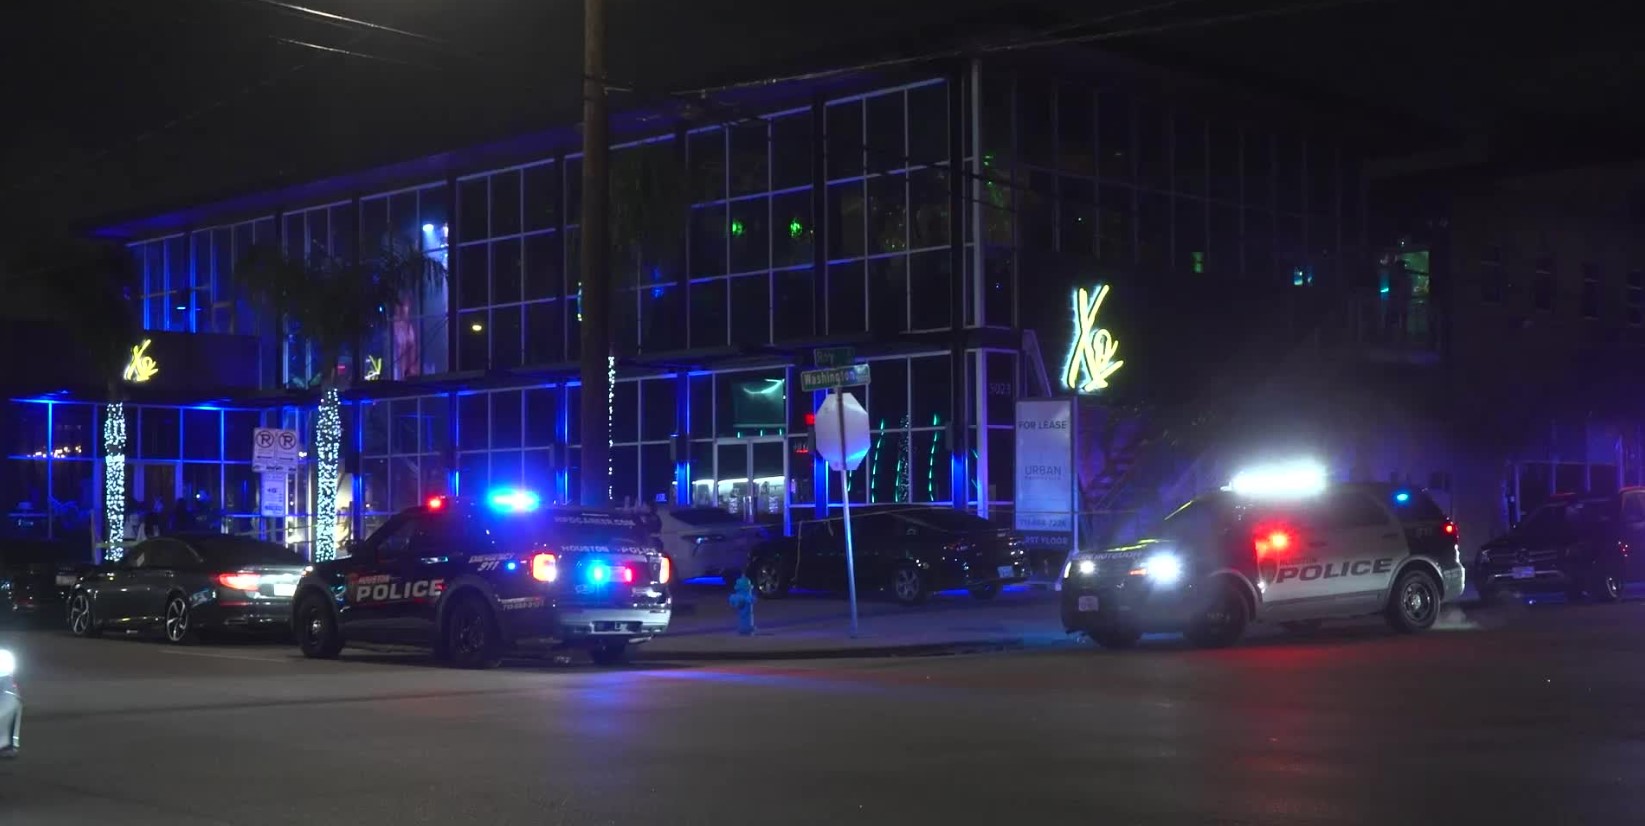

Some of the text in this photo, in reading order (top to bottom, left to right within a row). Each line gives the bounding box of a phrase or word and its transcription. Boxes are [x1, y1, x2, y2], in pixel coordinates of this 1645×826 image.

[803, 370, 856, 385] Washington
[1018, 421, 1067, 430] FOR LEASE
[1024, 465, 1062, 476] URBAN
[560, 545, 610, 553] HOUSTON
[477, 560, 500, 572] 911
[1276, 558, 1394, 584] POLICE
[356, 579, 444, 602] POLICE
